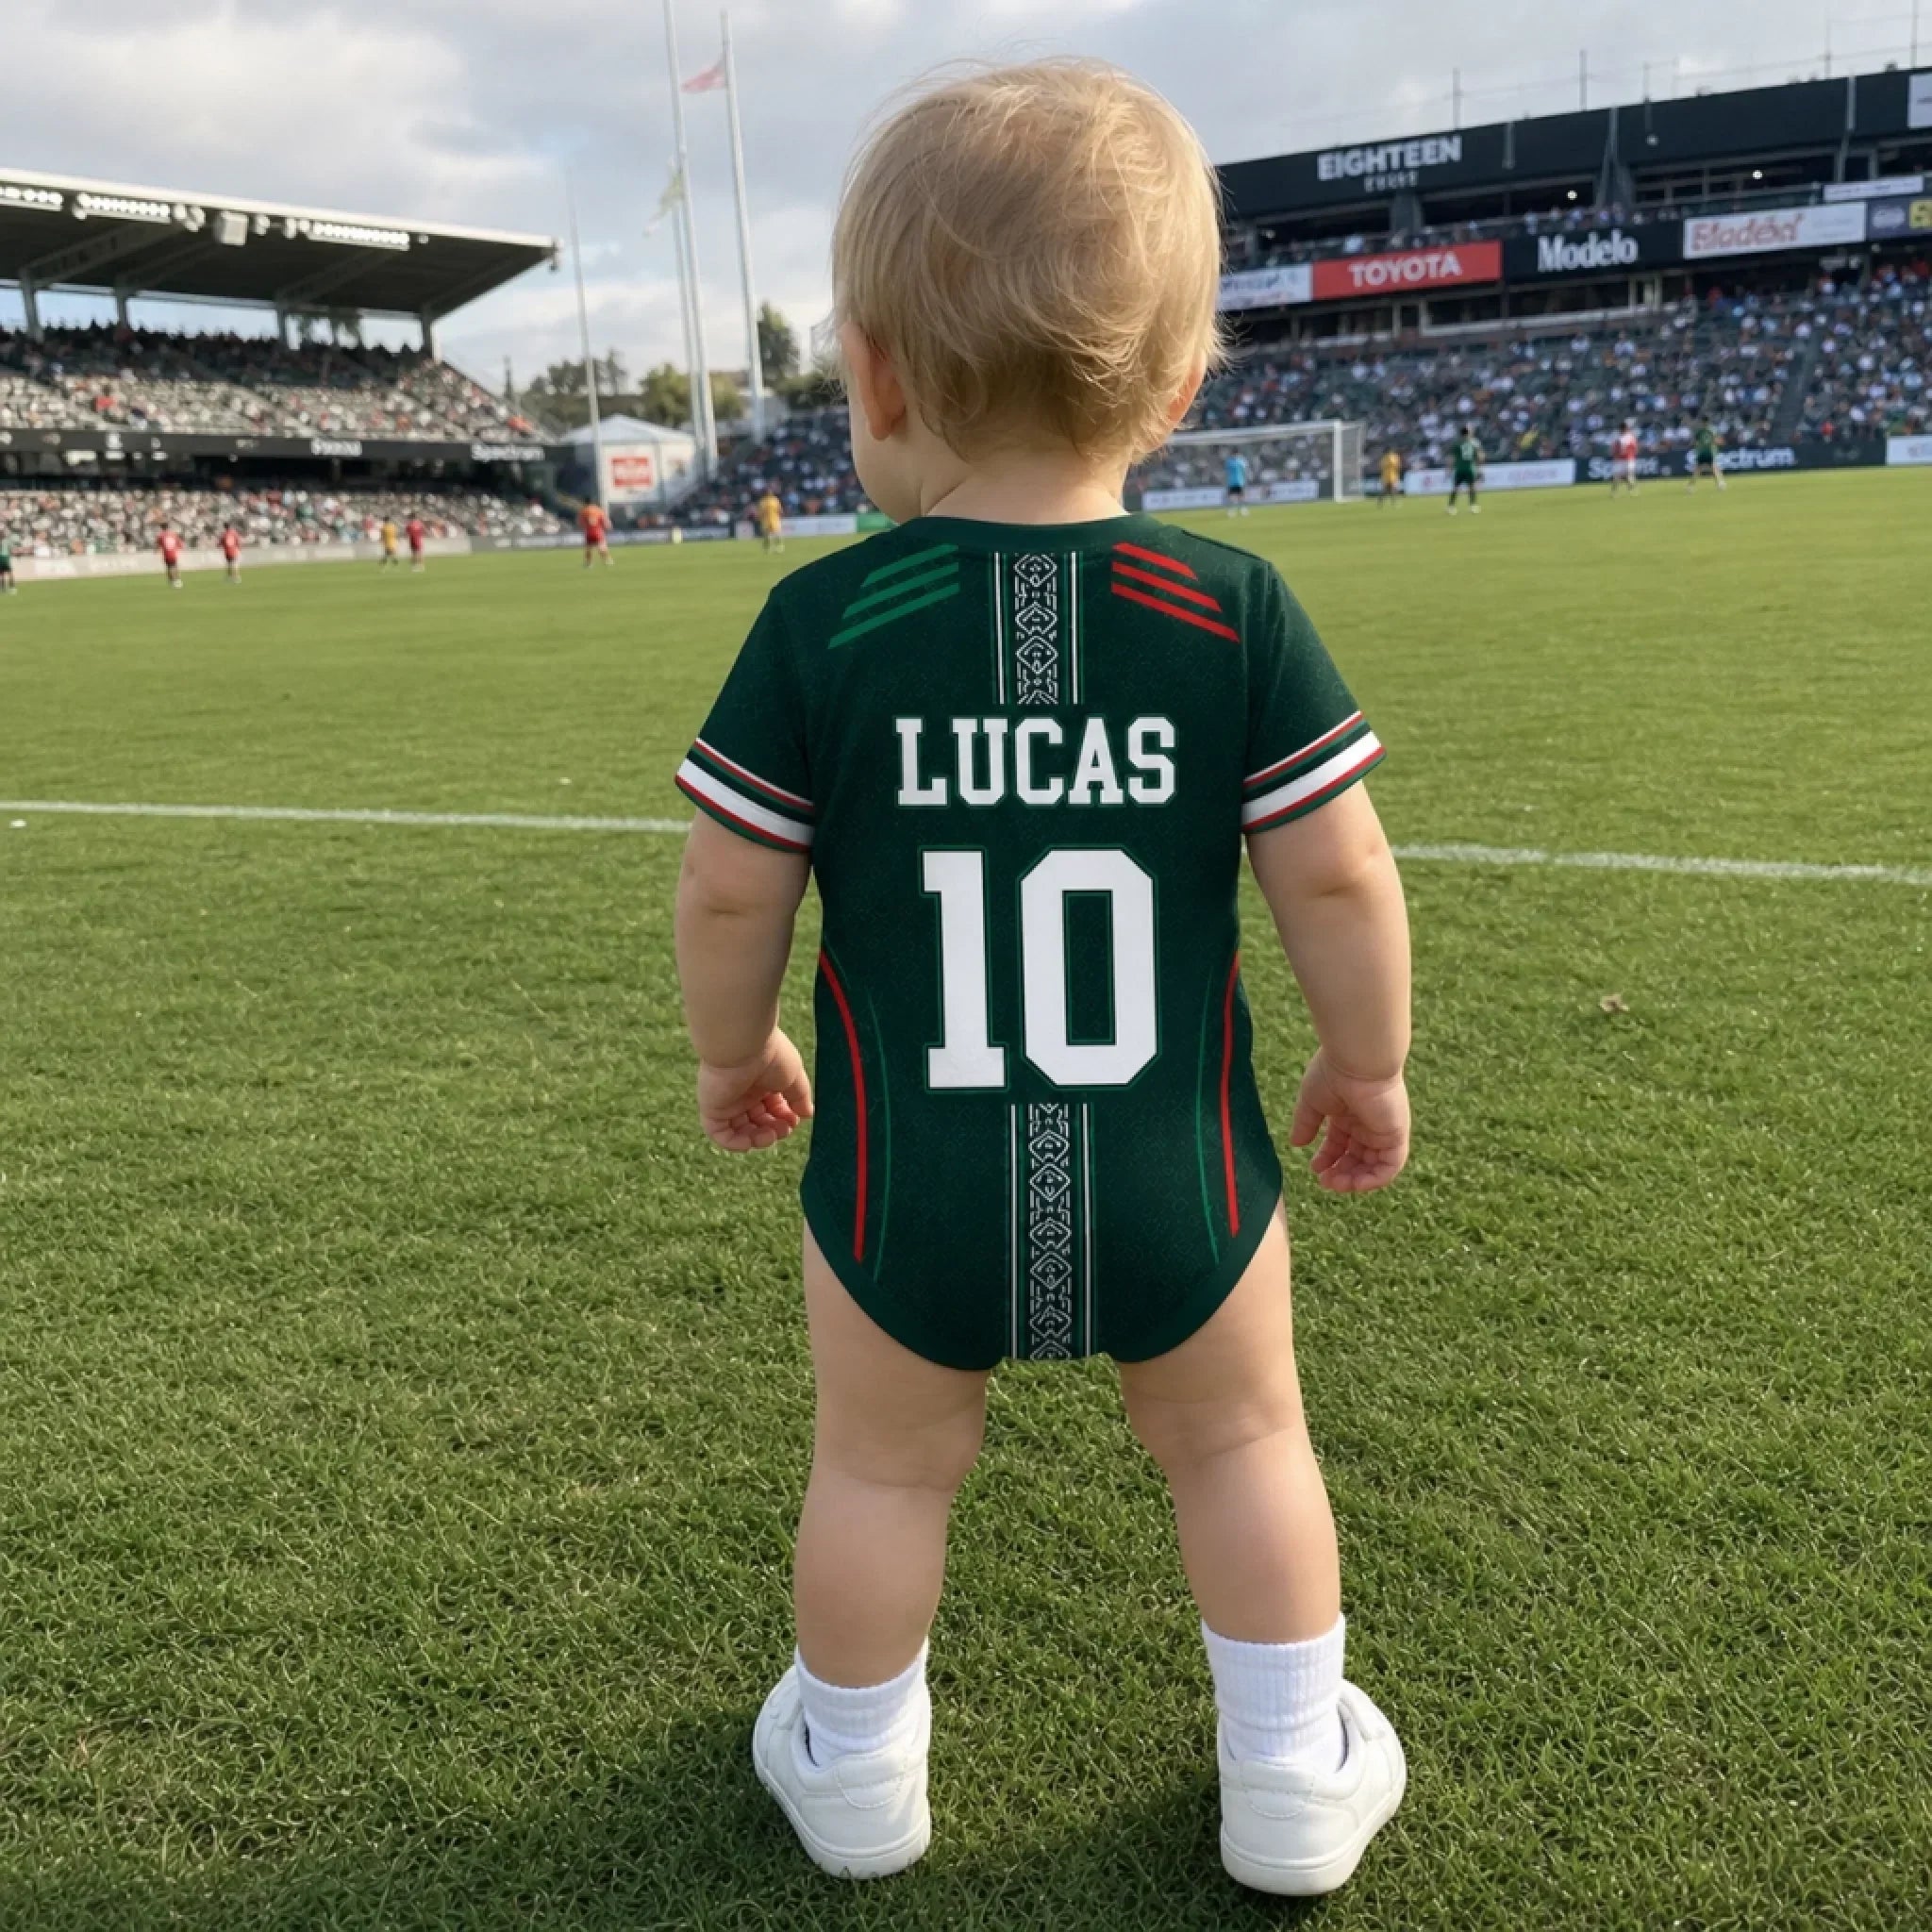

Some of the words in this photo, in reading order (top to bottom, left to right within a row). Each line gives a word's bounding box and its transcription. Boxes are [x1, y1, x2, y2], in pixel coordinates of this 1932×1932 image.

[1317, 135, 1461, 180] EIGHTEEN
[1347, 251, 1461, 287] TOYOTA
[1538, 228, 1638, 272] Modelo
[1685, 447, 1794, 472] Sectrum
[895, 716, 1176, 806] LUCAS
[923, 849, 1158, 1089] 10
